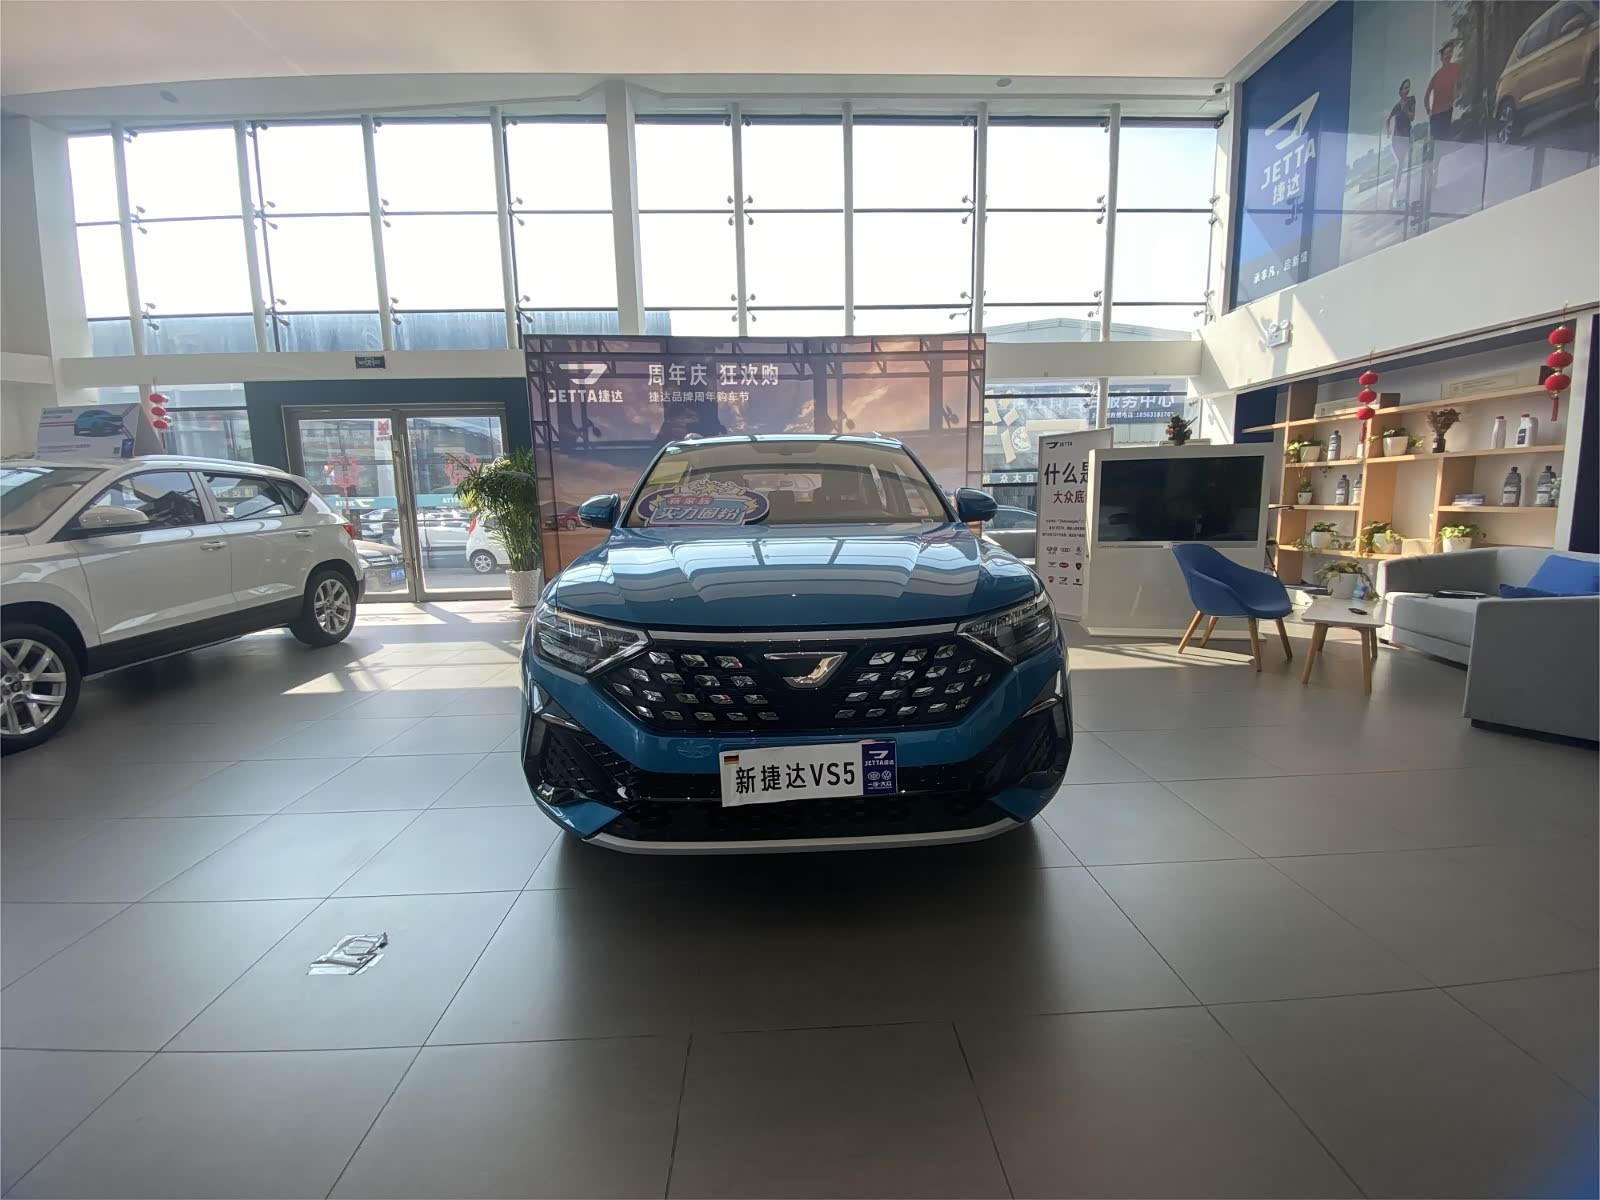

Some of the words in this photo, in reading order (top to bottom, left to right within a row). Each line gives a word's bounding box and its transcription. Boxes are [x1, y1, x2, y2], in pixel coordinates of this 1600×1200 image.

[1261, 138, 1316, 189] JETTA
[1272, 173, 1301, 205] 捷达
[648, 364, 708, 386] 周年庆
[719, 363, 779, 386] 狂欢购
[648, 391, 750, 403] 捷达品牌周年购车节
[1053, 490, 1088, 504] 大众底
[735, 762, 856, 794] 新捷达VS5
